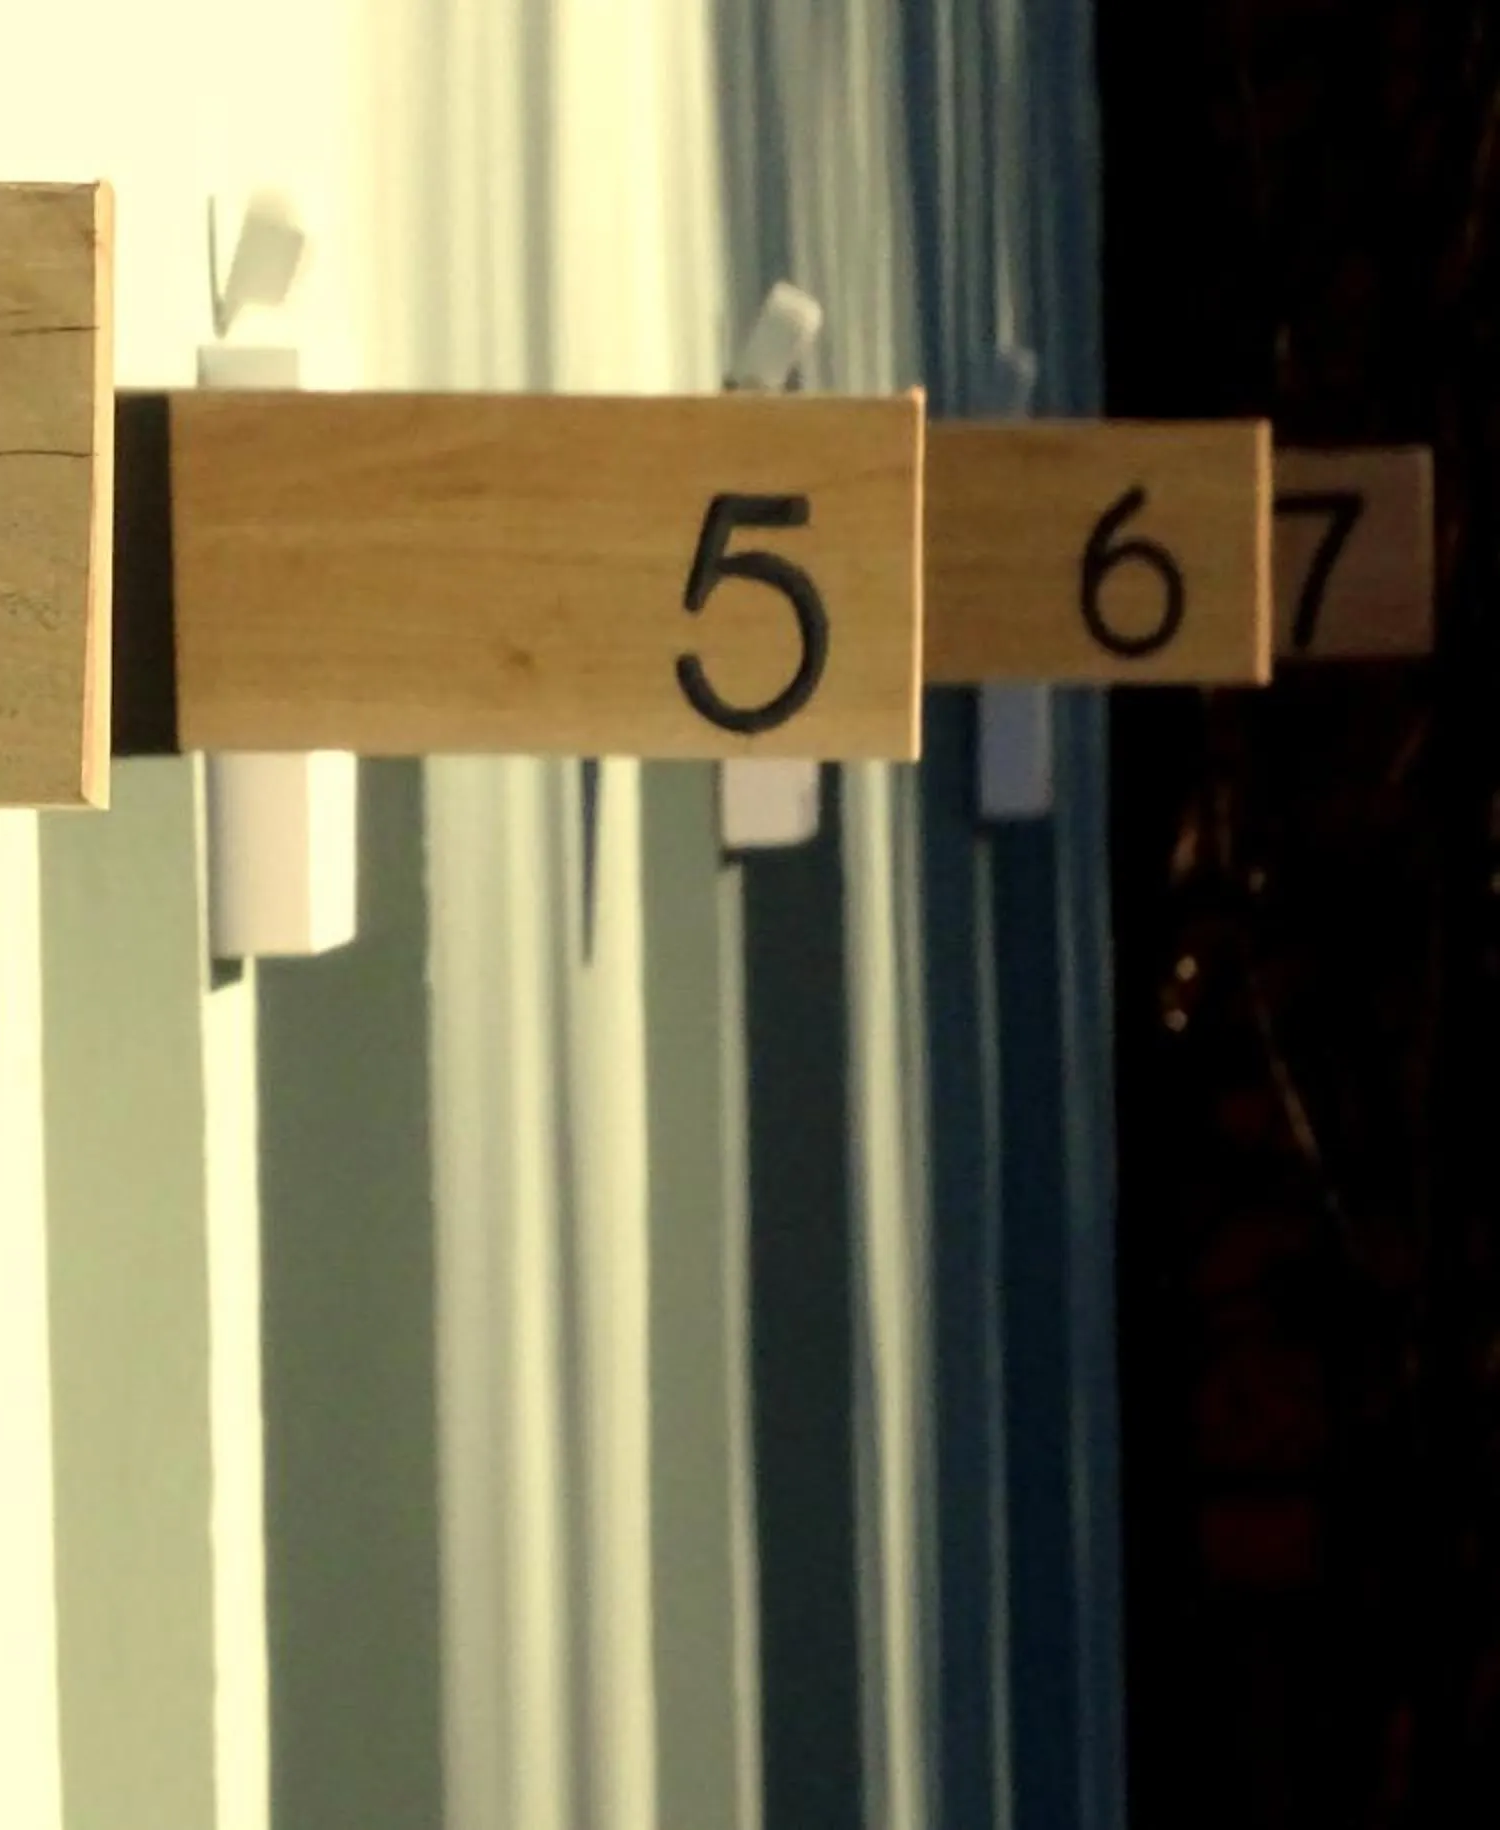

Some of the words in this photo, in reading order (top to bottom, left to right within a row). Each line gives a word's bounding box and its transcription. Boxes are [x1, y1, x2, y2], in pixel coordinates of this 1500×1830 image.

[675, 492, 830, 734] 5
[1079, 486, 1185, 658] 6
[1274, 490, 1365, 648] 7
